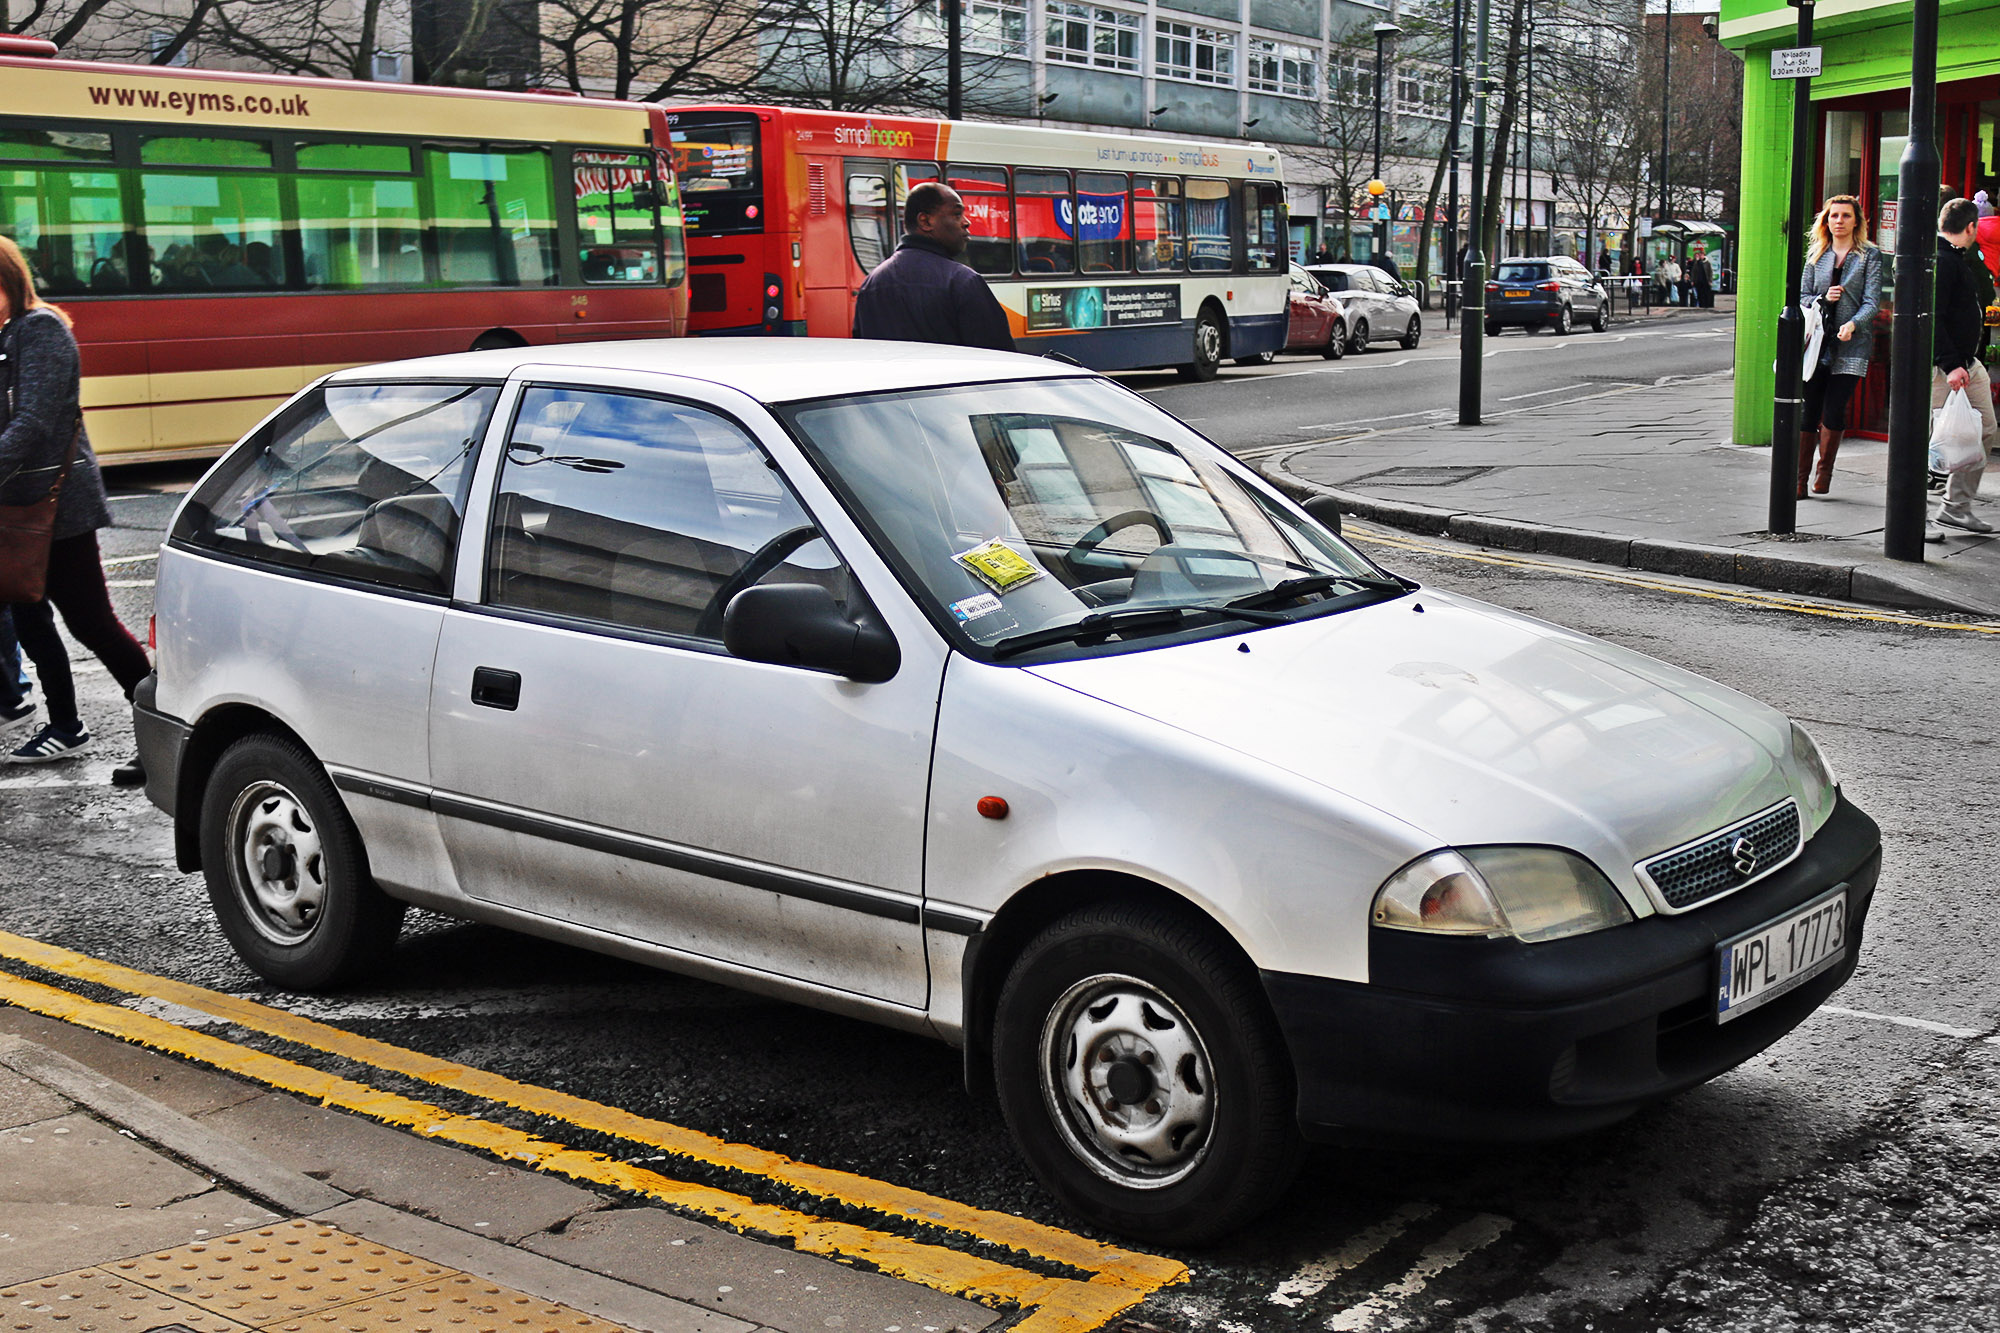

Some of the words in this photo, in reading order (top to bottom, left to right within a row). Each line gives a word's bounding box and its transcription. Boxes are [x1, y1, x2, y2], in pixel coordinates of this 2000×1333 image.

[1790, 50, 1811, 58] loading
[88, 86, 310, 116] www.eyms.co.uk
[1041, 293, 1061, 307] Sirius
[1732, 934, 1777, 1000] WPL
[1787, 899, 1844, 974] 17773
[1719, 985, 1729, 1001] PL
